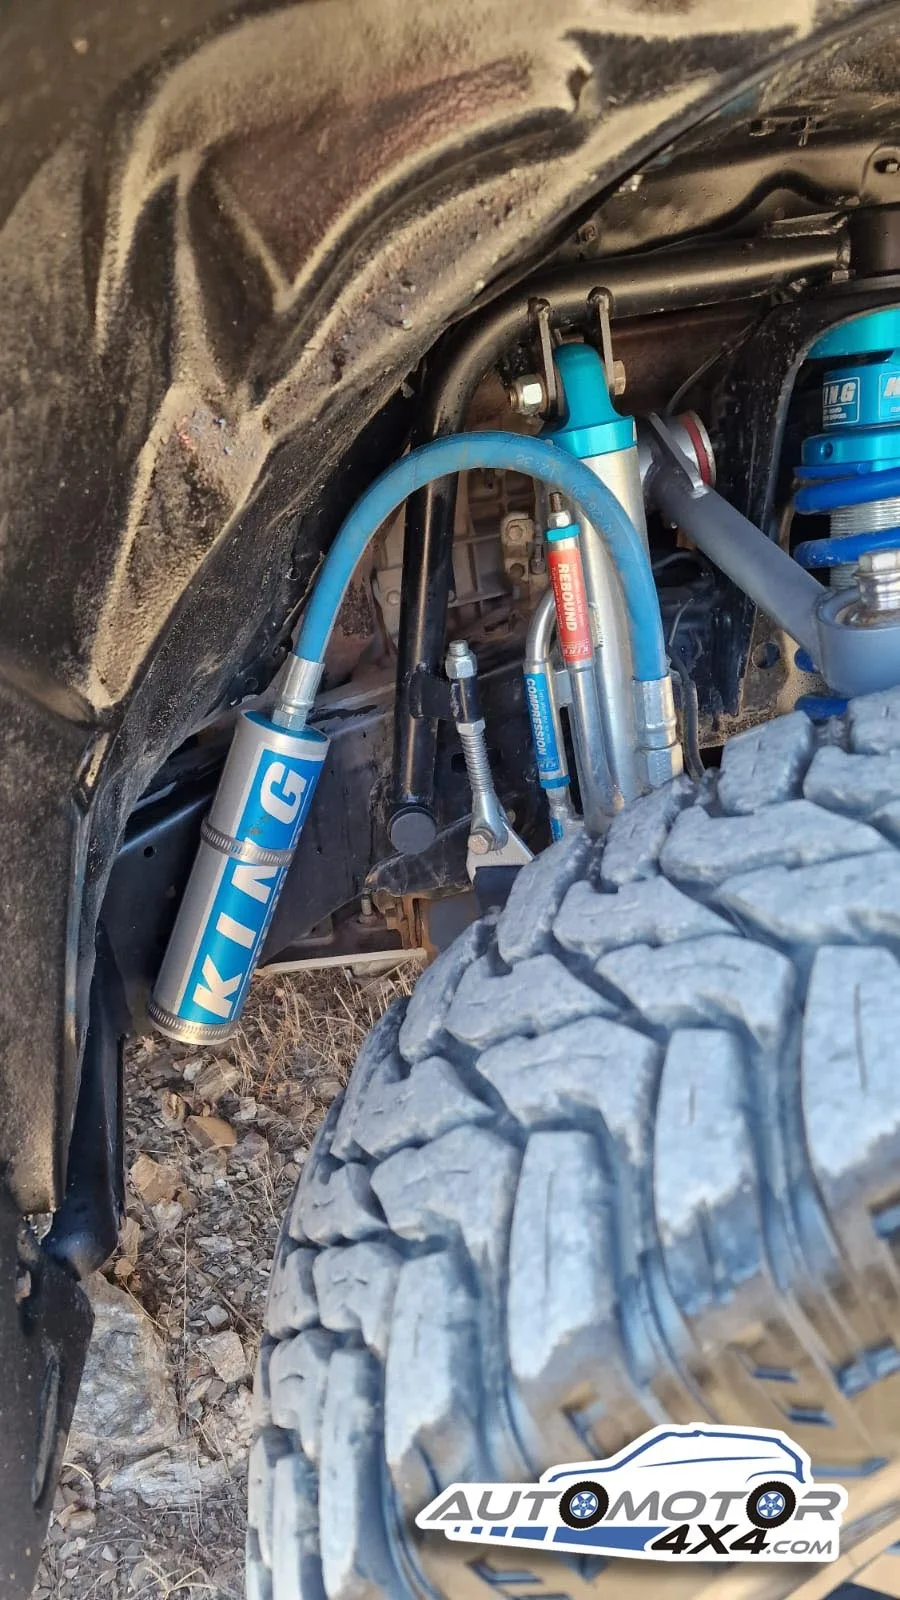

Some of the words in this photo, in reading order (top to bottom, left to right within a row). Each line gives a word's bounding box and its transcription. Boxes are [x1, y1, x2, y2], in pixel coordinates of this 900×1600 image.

[823, 382, 857, 405] ING
[557, 563, 578, 632] REBOUND
[526, 677, 547, 756] COMPRESSION
[193, 762, 307, 1018] KING
